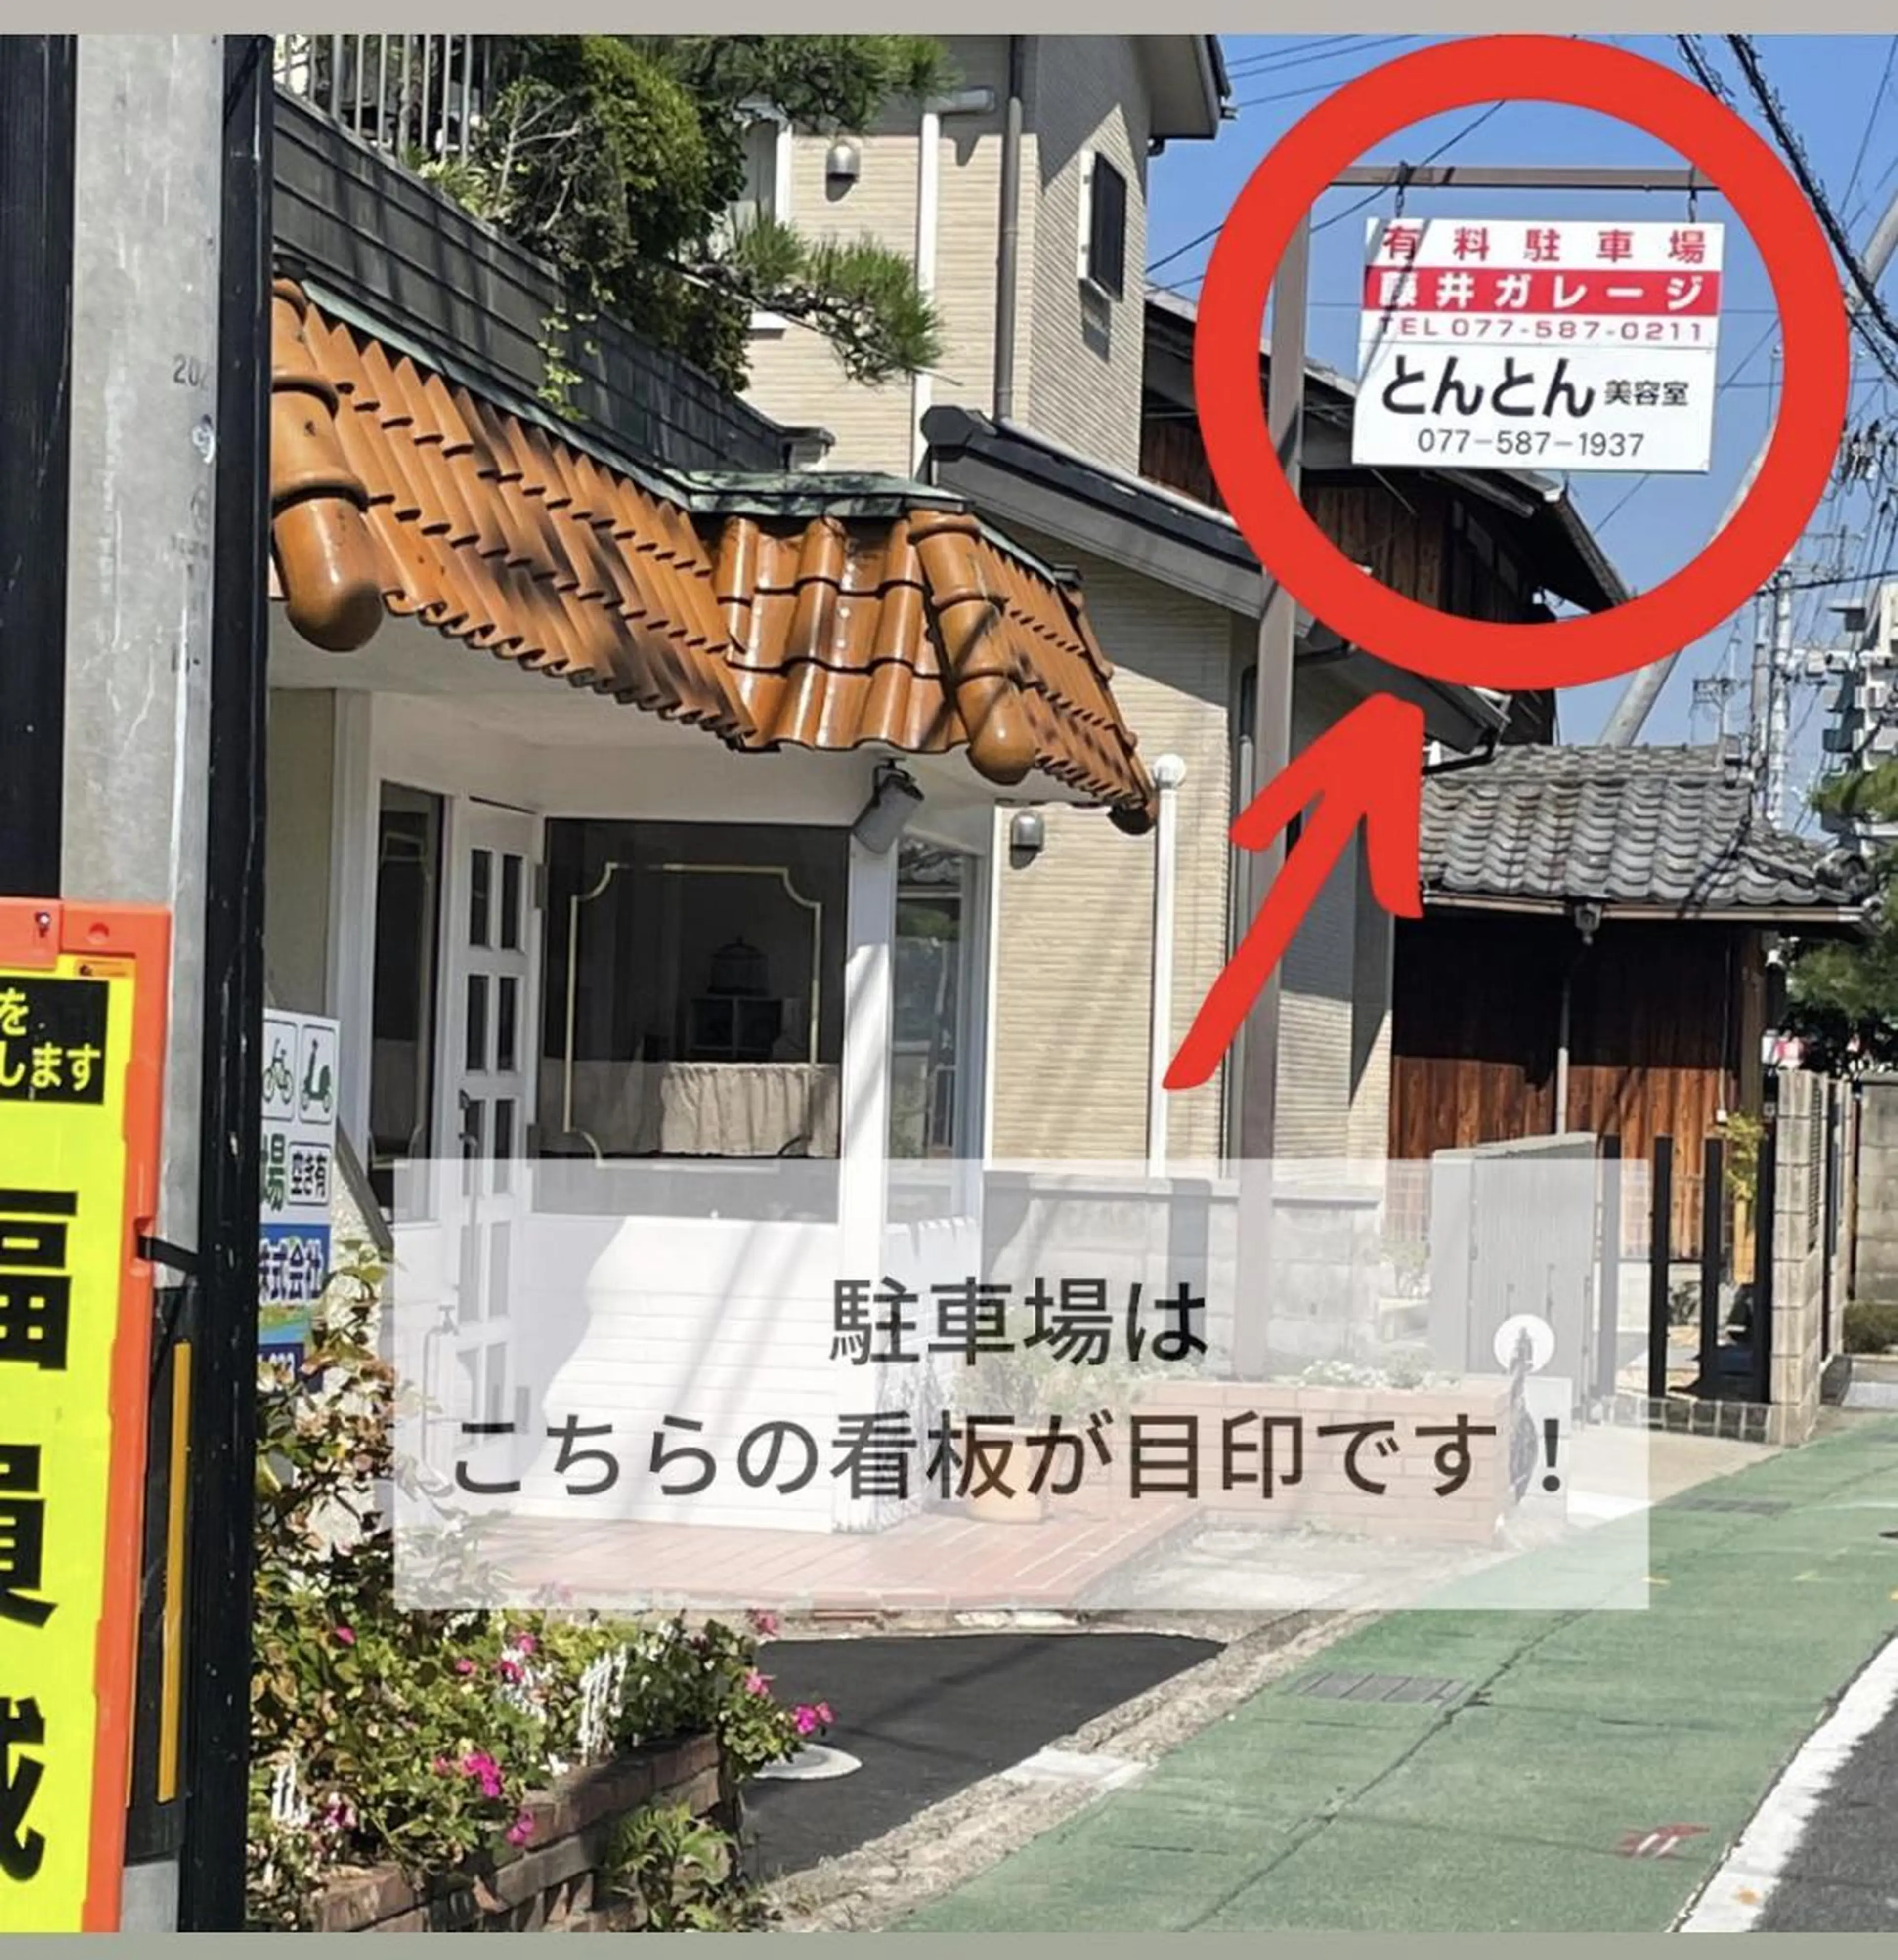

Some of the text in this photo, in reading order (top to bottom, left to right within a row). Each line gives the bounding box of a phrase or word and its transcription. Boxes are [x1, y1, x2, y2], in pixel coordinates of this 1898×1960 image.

[1383, 226, 1706, 264] 有料駐車場
[1379, 317, 1701, 341] TEL 077-587-0211
[1382, 355, 1688, 418] とんとん 美容室
